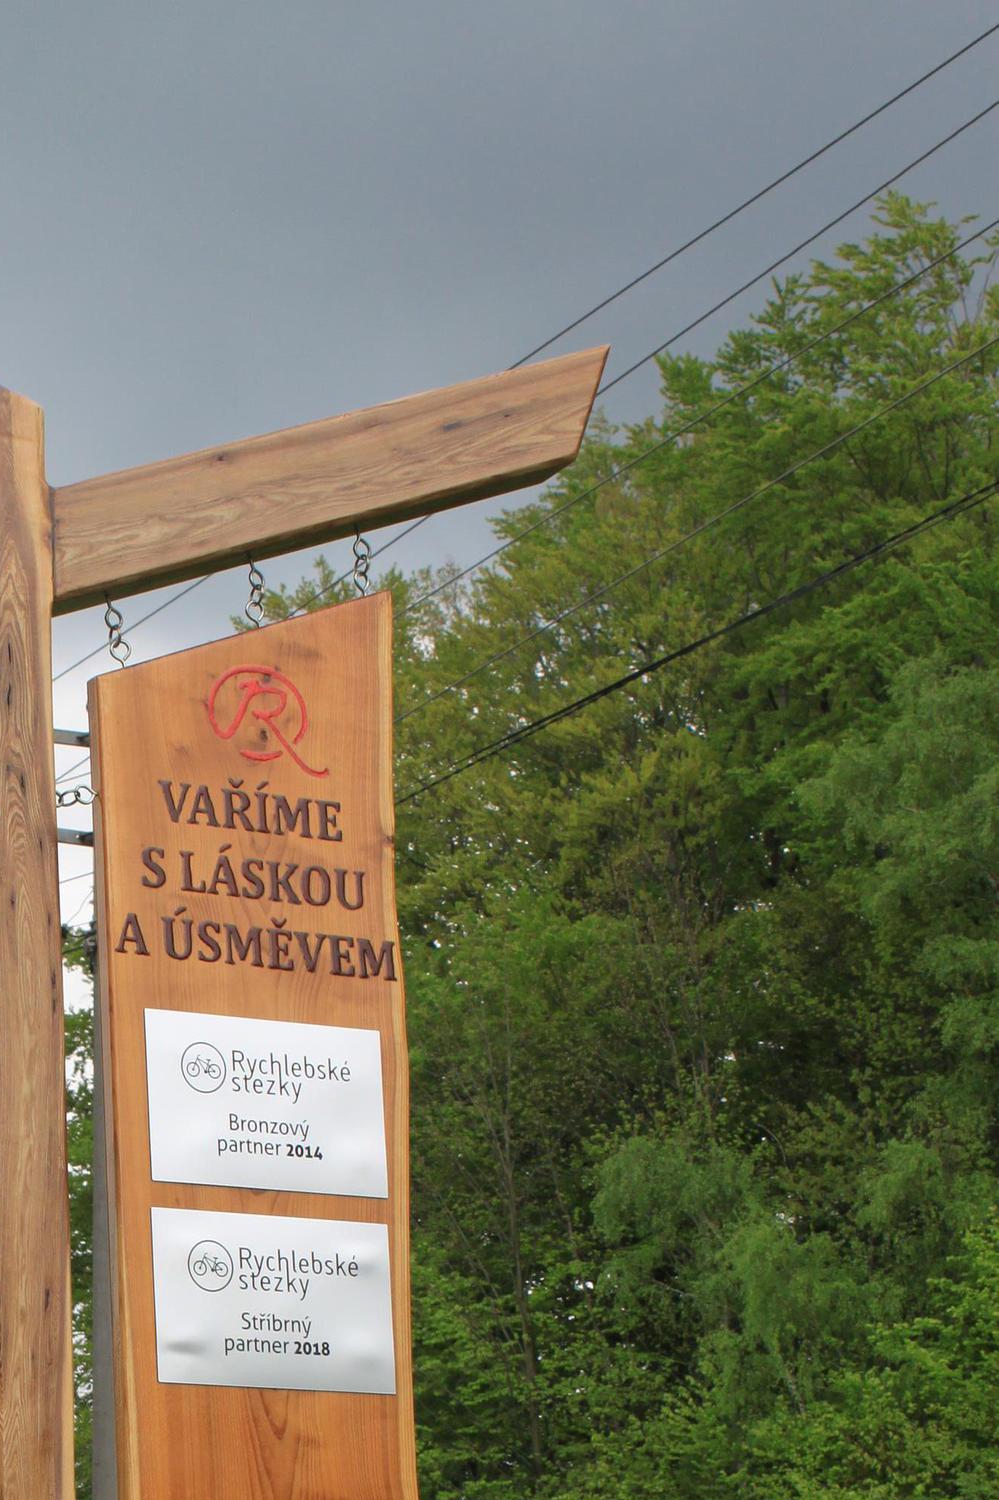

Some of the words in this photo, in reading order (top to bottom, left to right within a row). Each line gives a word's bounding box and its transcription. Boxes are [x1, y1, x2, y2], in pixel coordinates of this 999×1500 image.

[158, 778, 343, 842] VAŘÍME
[141, 846, 167, 889] S
[180, 844, 366, 911] LÁSKOU
[114, 912, 150, 956] A
[161, 906, 398, 982] ÚSMĚVEM
[231, 1049, 352, 1083] Rychlebské
[231, 1073, 303, 1104] stezky
[228, 1113, 310, 1142] Bronzový
[217, 1136, 281, 1157] partner
[286, 1143, 324, 1161] 2014
[239, 1247, 359, 1279] Rychlebské
[239, 1271, 310, 1301] stezky
[241, 1312, 313, 1339] Stříbrný
[224, 1334, 290, 1356] partner
[294, 1341, 331, 1357] 2018
